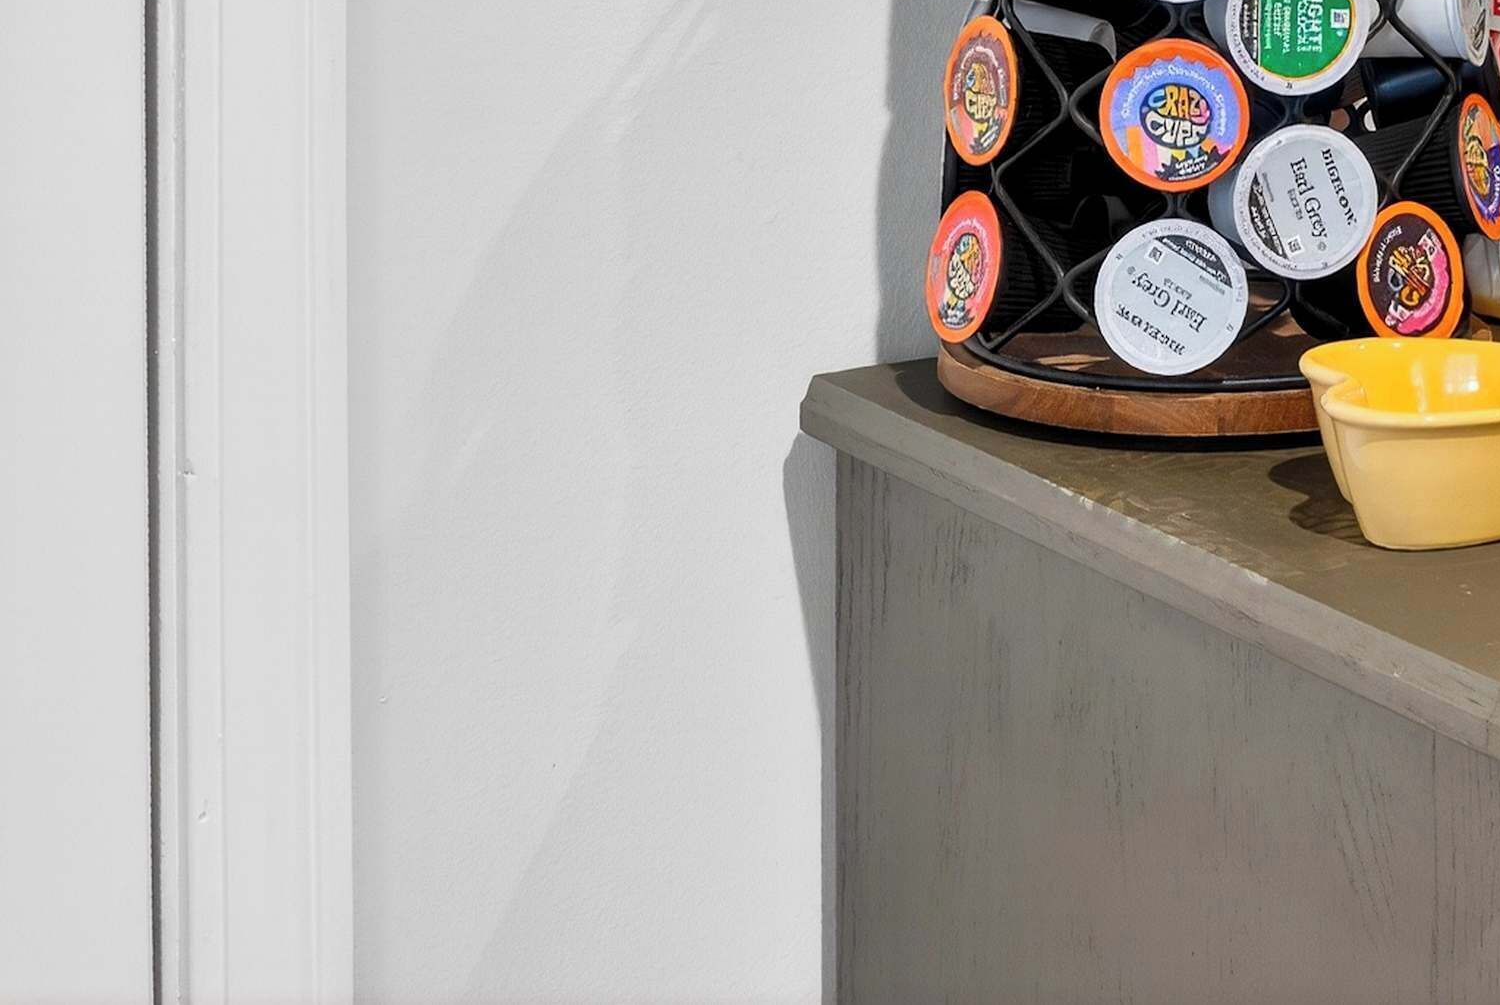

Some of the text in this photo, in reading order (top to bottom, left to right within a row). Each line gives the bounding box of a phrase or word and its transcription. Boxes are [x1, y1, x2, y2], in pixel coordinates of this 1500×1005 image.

[1145, 110, 1209, 147] CUPS
[1290, 157, 1314, 196] Earl
[1304, 197, 1328, 238] Grey
[1132, 272, 1171, 308] Grey
[1170, 300, 1207, 333] Earl
